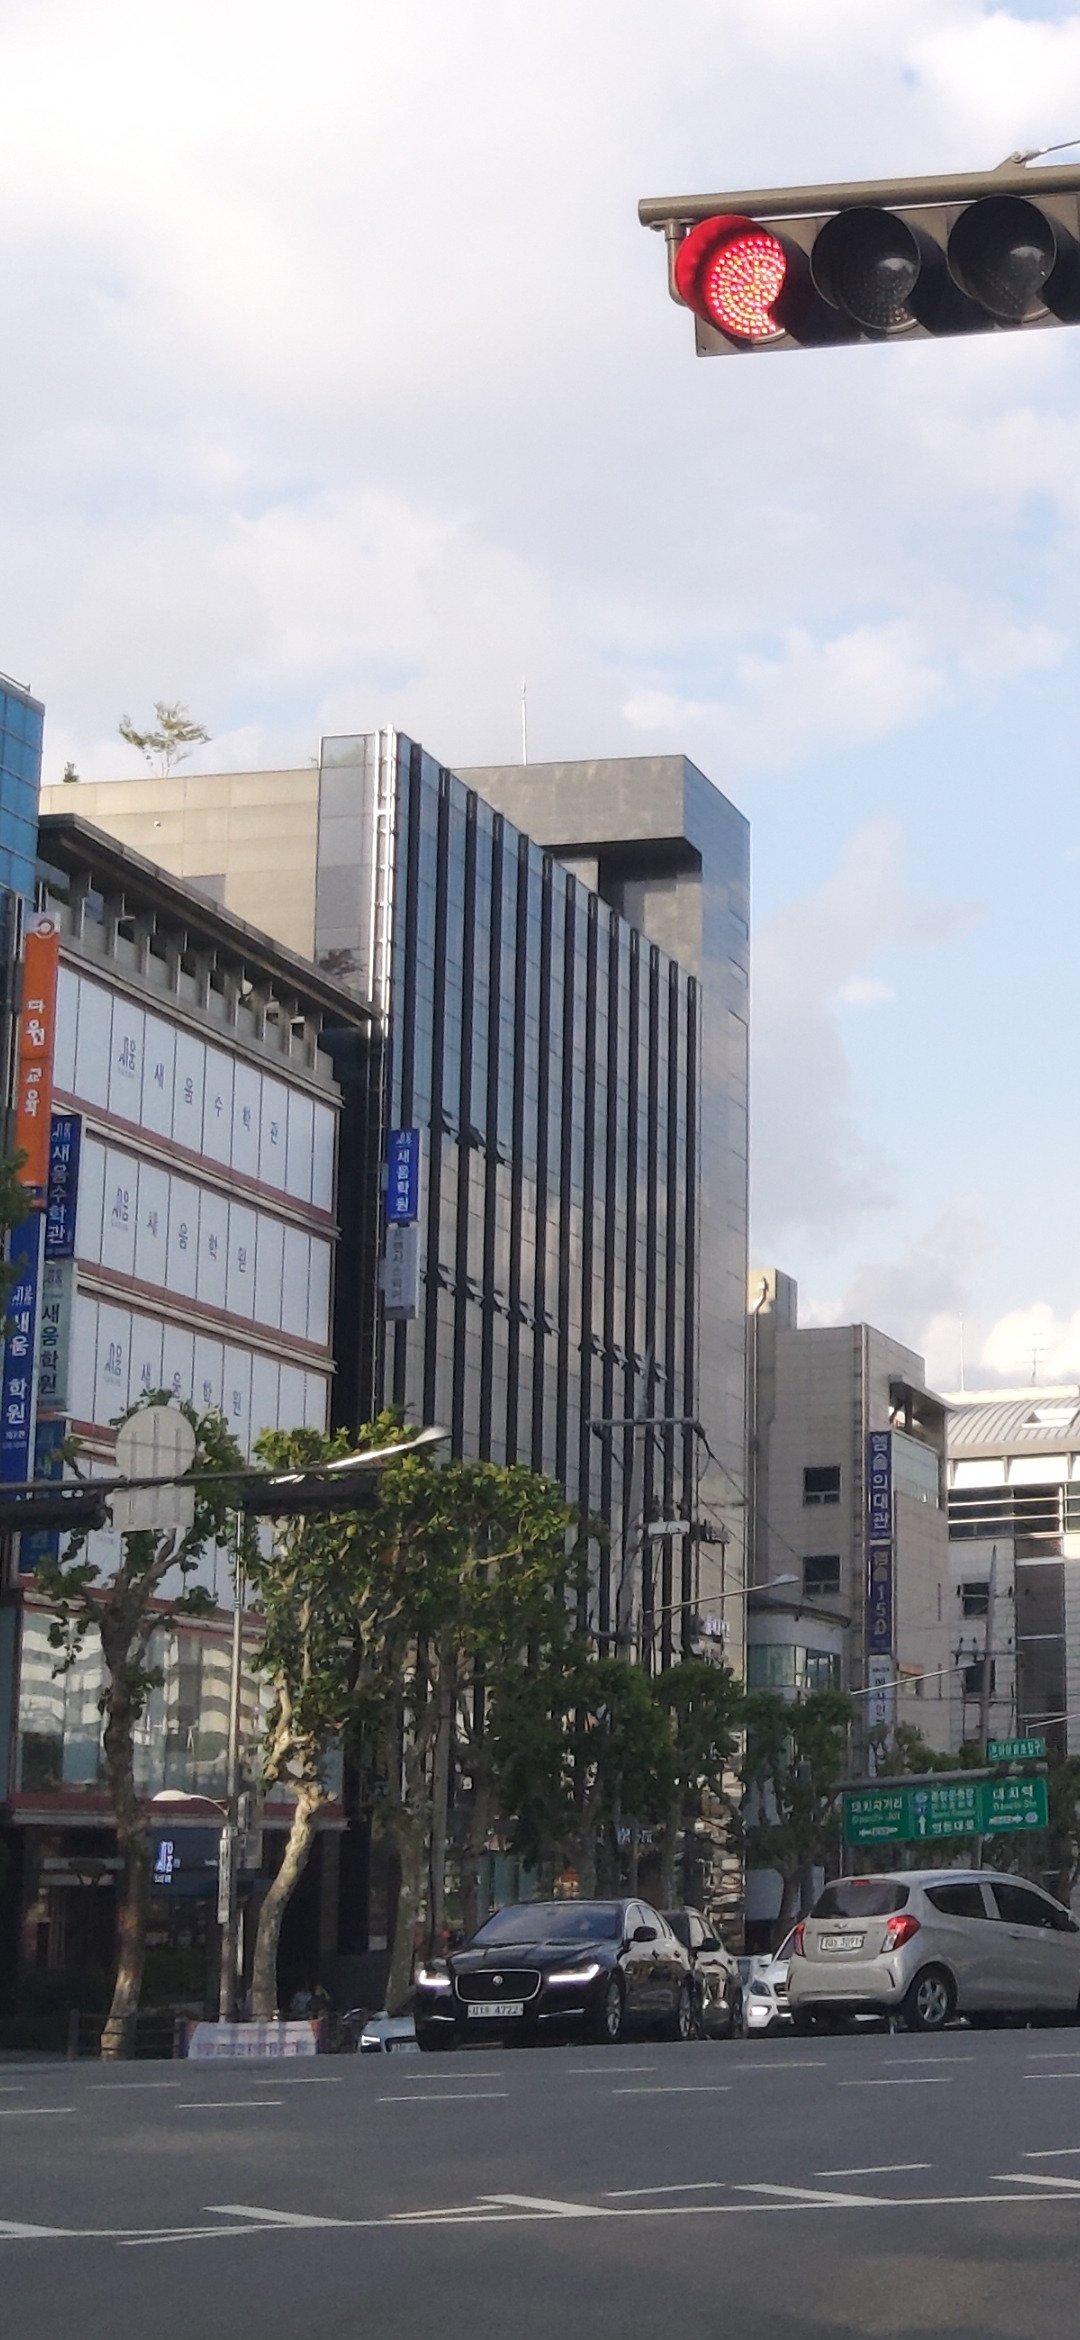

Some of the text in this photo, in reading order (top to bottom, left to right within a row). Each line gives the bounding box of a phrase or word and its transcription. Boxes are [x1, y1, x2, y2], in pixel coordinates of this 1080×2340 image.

[46, 1143, 71, 1245] 새움수학관
[396, 1149, 410, 1212] 새움학원
[10, 1311, 30, 1357] 새움
[39, 1303, 60, 1394] 새움학원
[5, 1377, 28, 1424] 학원
